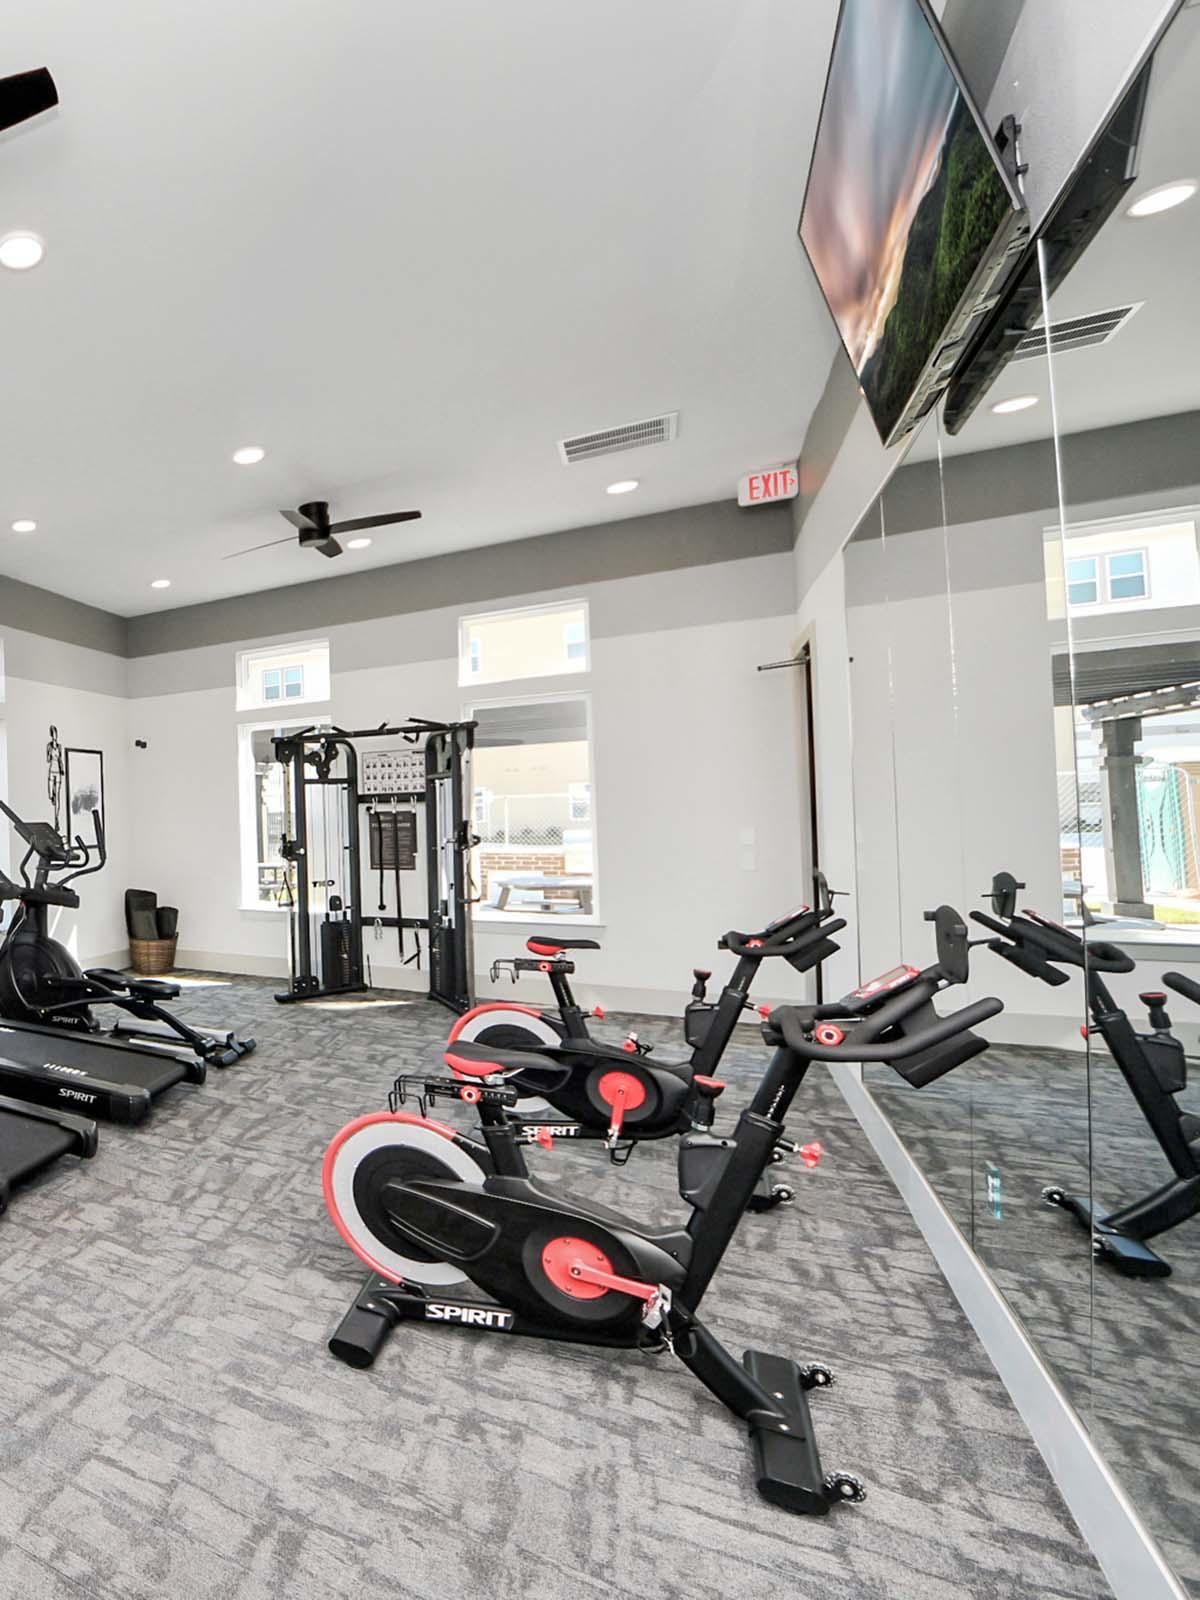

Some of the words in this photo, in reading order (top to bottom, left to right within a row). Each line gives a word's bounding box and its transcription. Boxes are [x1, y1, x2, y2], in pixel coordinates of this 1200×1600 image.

[748, 469, 791, 500] EXIT
[58, 1088, 97, 1104] SPIRIT
[425, 1304, 512, 1327] SPIRIT
